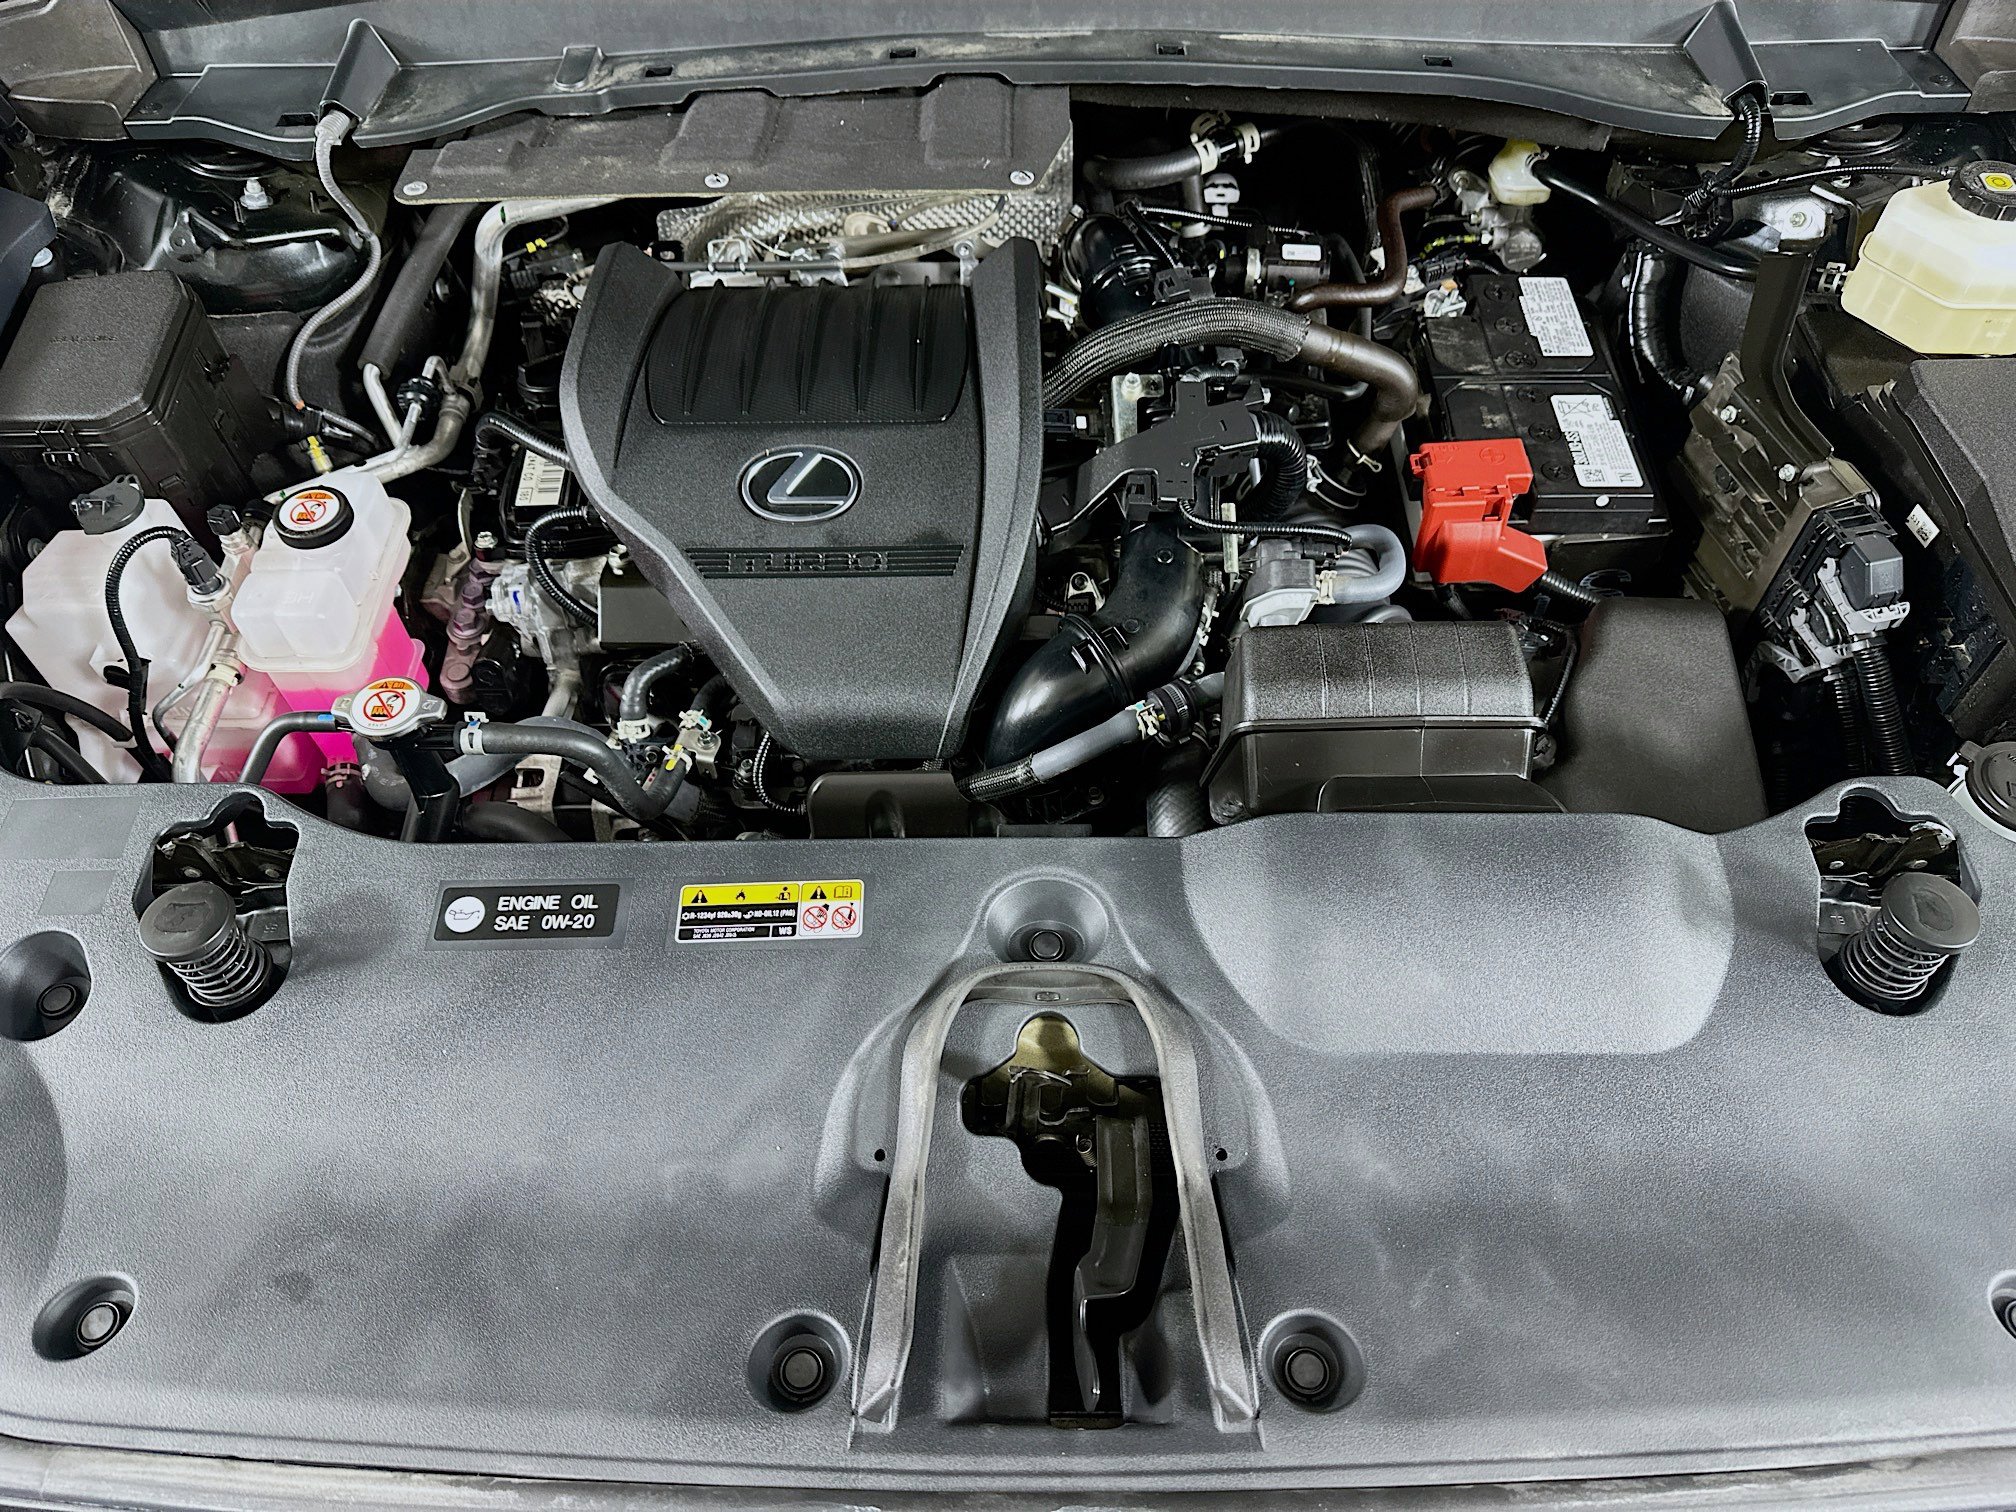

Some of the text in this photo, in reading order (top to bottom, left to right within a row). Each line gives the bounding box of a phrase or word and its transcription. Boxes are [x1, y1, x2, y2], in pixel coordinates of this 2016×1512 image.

[732, 551, 884, 572] TURBO
[497, 894, 599, 911] ENGINE OIL
[494, 914, 596, 931] SAE 0W-20
[778, 926, 793, 936] WS
